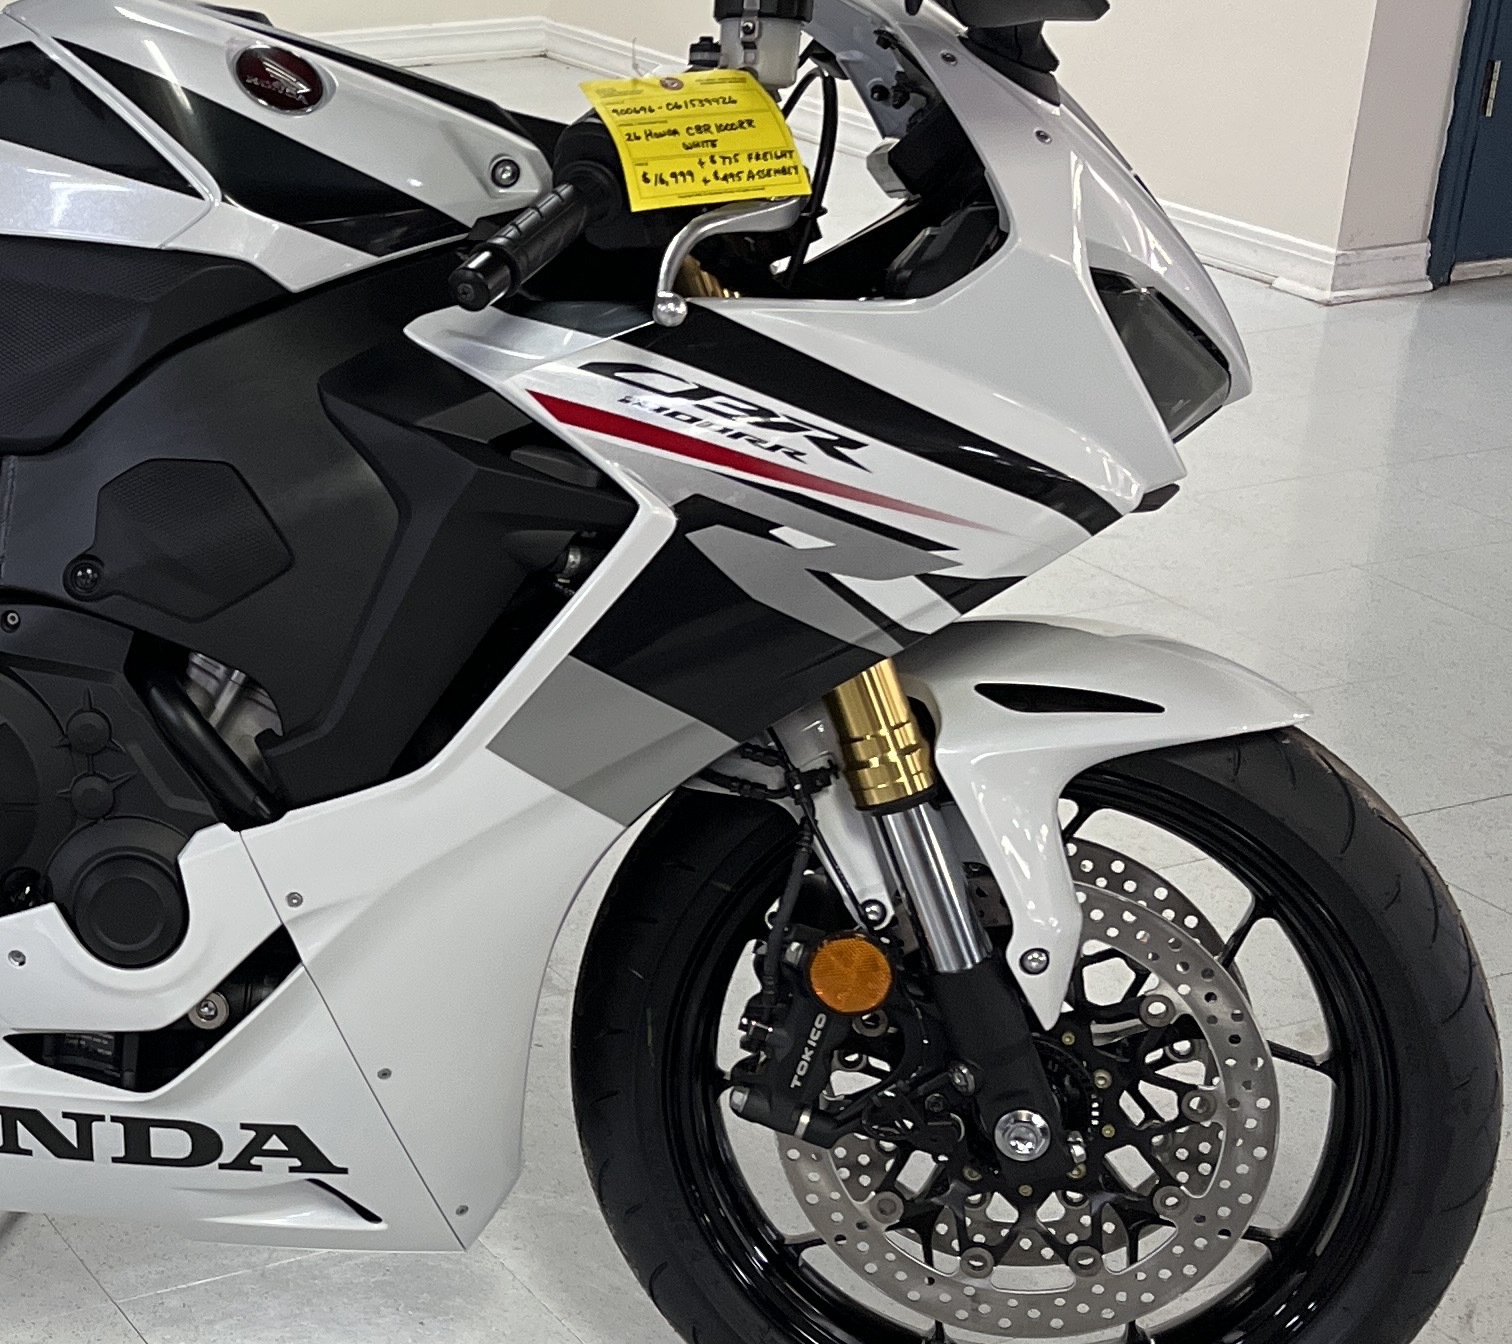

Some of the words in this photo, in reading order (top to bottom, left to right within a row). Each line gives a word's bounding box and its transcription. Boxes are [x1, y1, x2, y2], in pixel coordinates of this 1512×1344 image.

[685, 122, 714, 137] CBR
[681, 138, 719, 151] WHITE
[746, 149, 795, 164] FREIGHT
[745, 165, 800, 181] ASSEMBLY
[578, 362, 873, 474] CBR
[789, 1012, 828, 1089] TOKICO
